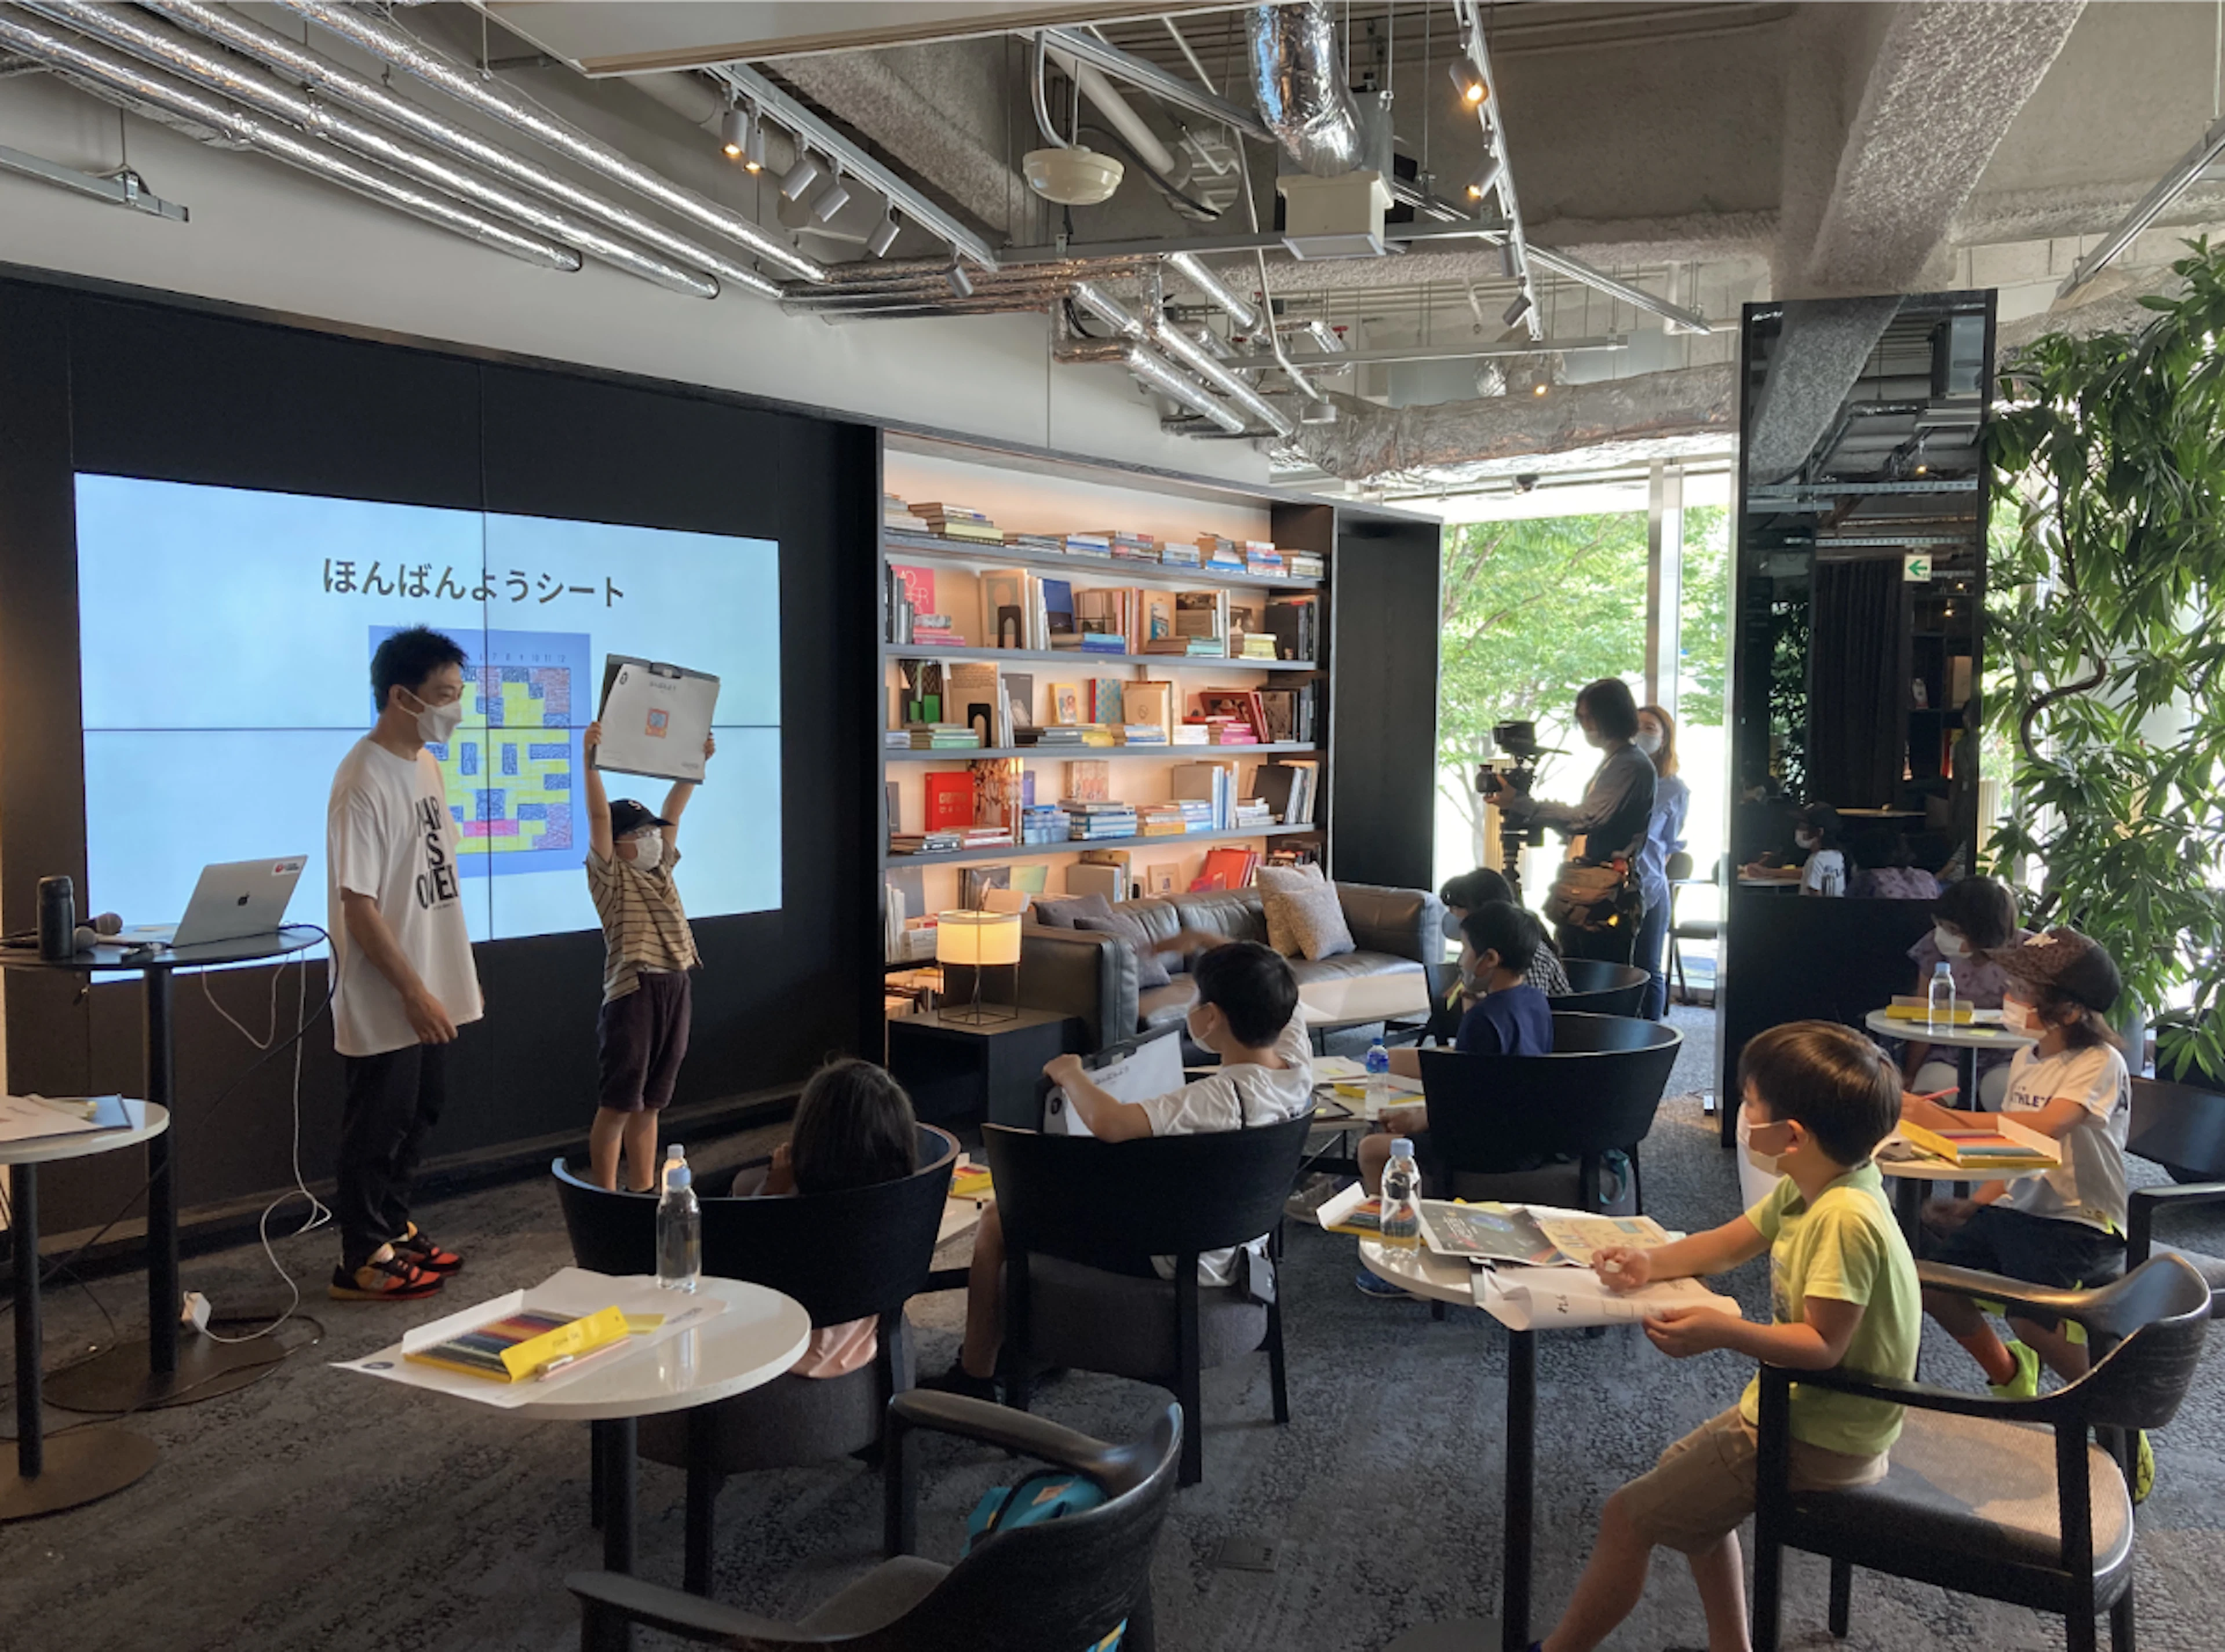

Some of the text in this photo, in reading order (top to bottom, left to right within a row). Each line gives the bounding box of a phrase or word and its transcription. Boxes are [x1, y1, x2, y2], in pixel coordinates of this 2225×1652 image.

[323, 558, 624, 607] ほんばんようシート
